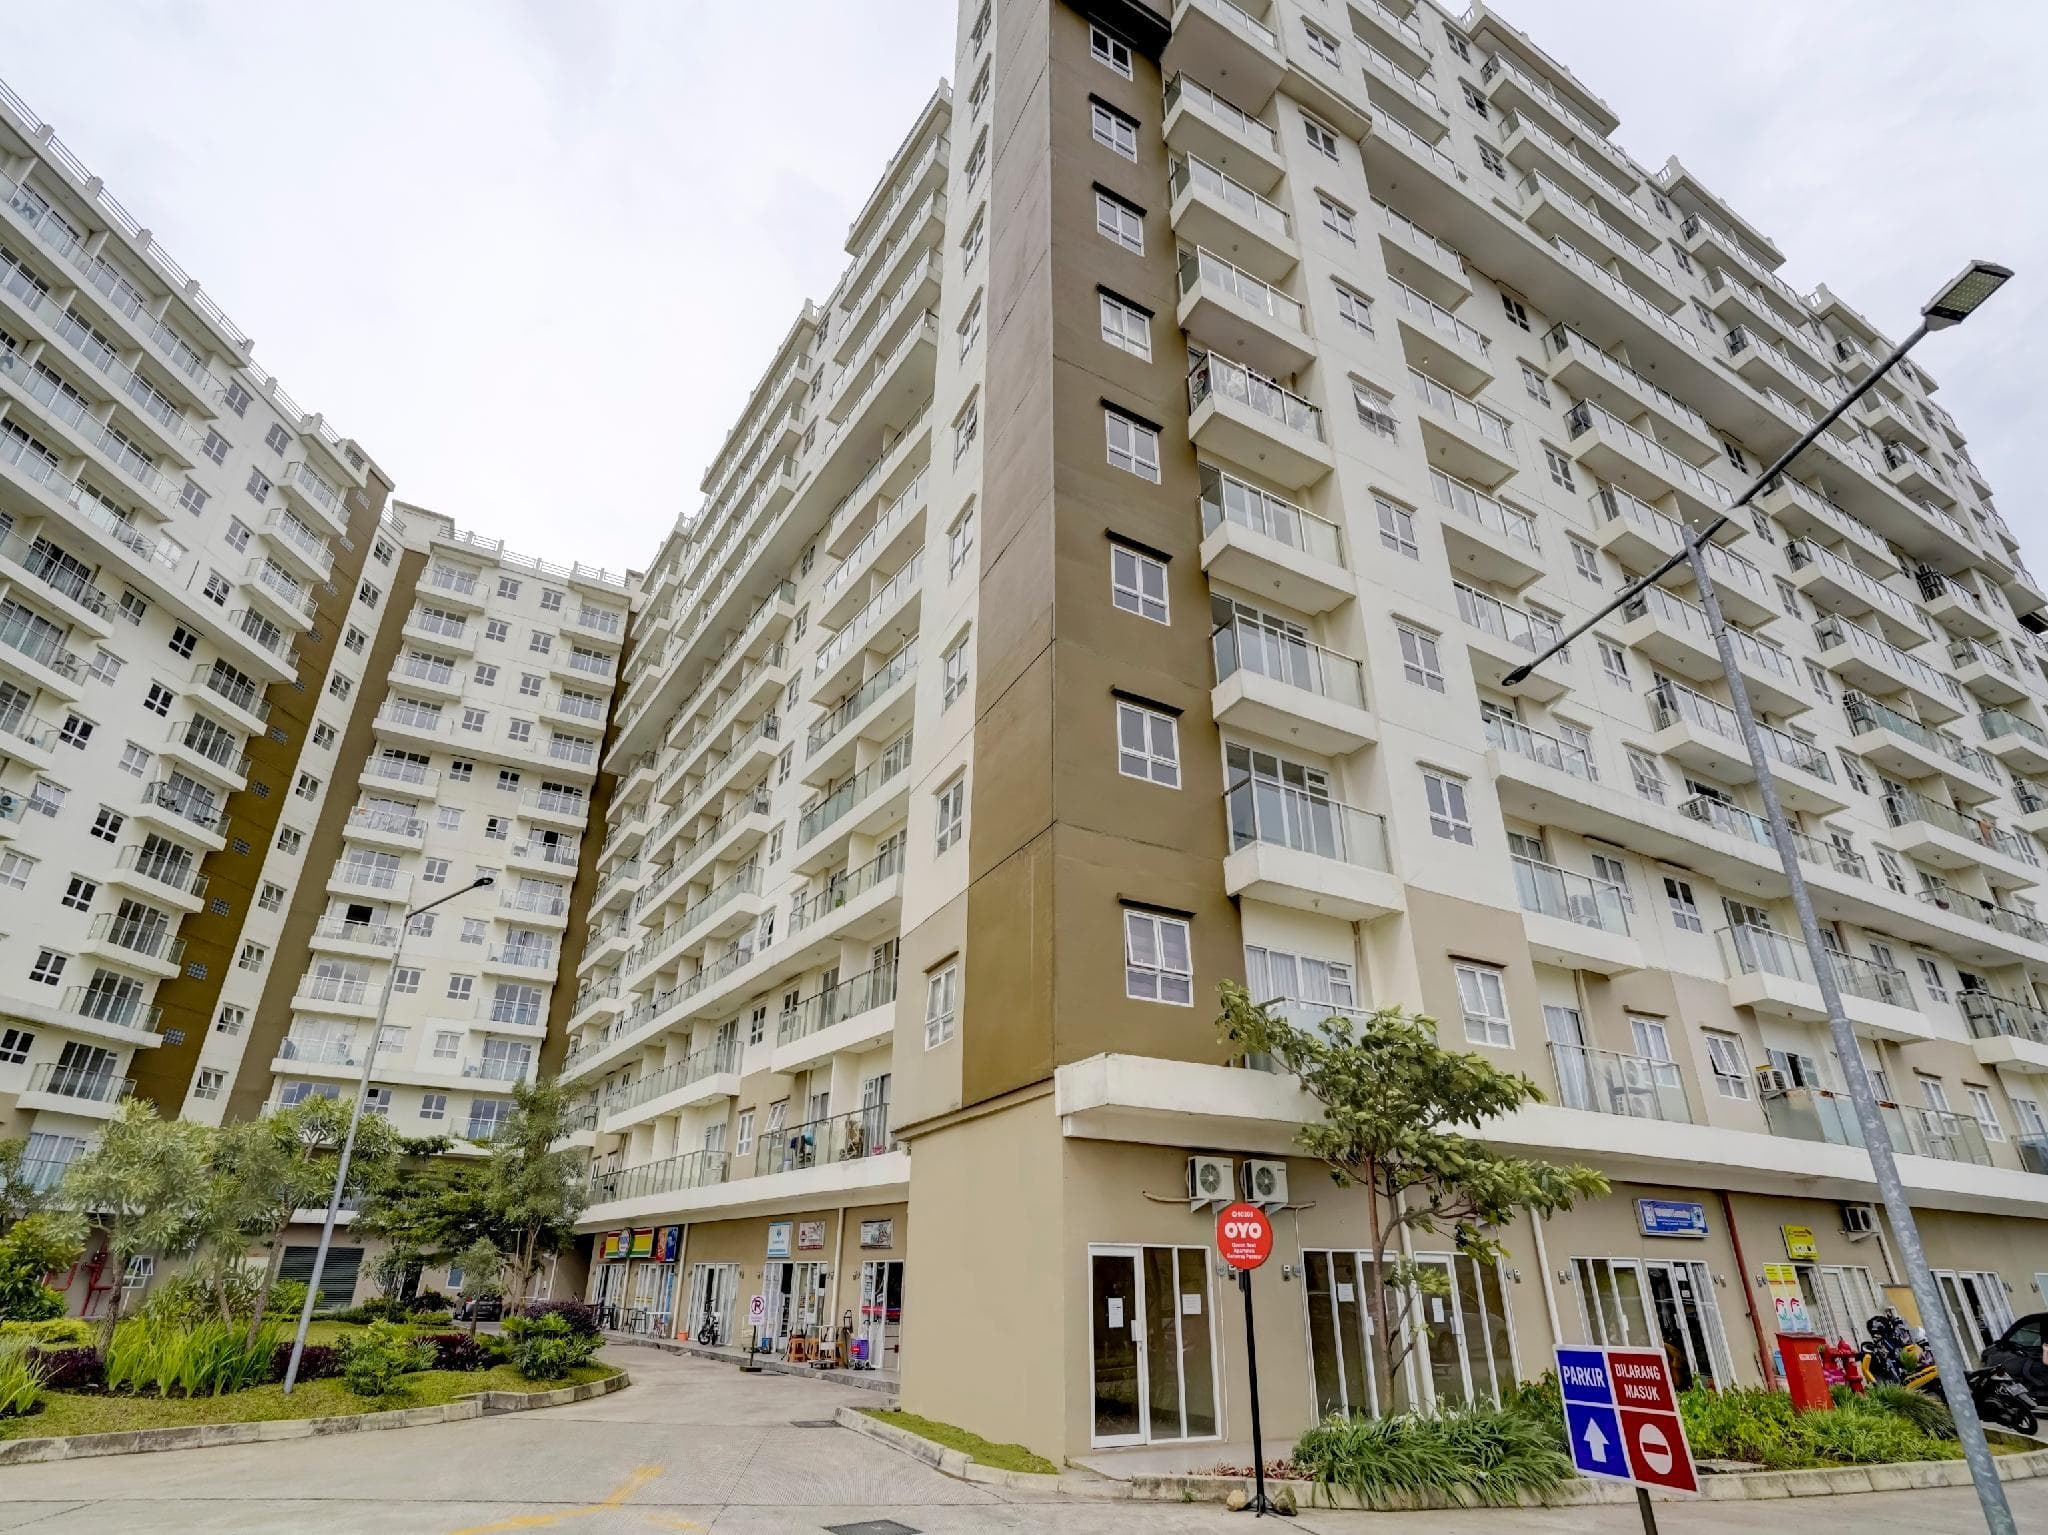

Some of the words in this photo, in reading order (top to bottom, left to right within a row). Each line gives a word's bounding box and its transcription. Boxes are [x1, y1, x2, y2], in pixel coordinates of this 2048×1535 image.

[1224, 1222, 1262, 1239] OYO
[1562, 1365, 1606, 1388] PARKIR
[1614, 1363, 1661, 1381] DILARANG
[1624, 1383, 1661, 1401] MASUK
